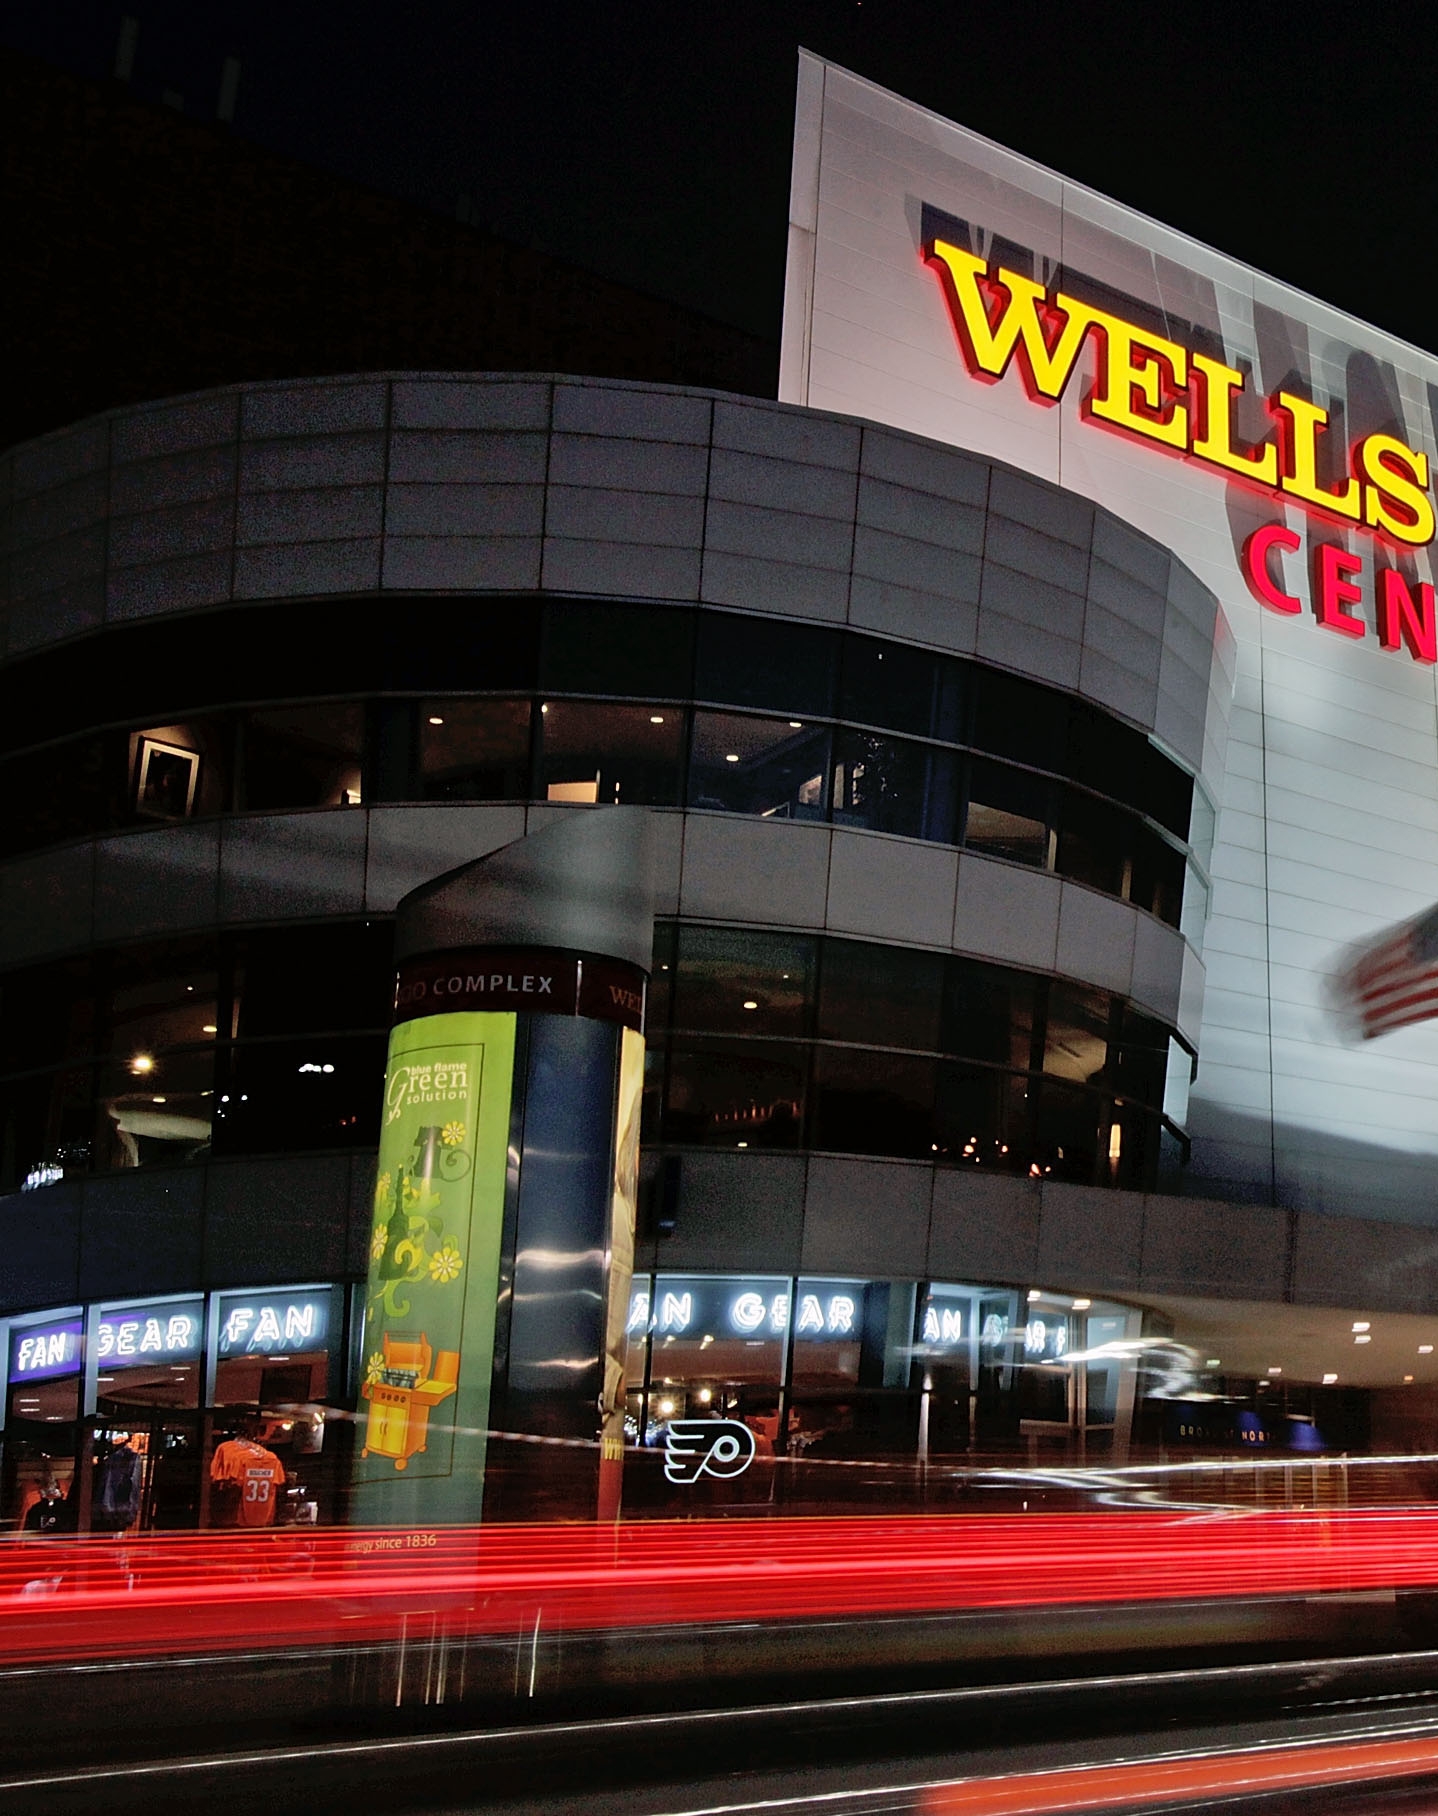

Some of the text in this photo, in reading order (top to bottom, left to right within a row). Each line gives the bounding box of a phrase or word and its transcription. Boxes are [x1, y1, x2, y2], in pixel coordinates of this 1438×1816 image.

[925, 238, 1437, 549] WELLS
[433, 974, 553, 996] COMPLEX
[411, 1062, 467, 1076] blue flame
[386, 1066, 468, 1126] Green
[407, 1089, 467, 1105] solution
[627, 1292, 855, 1332] AN GEAR
[923, 1307, 961, 1343] AN
[18, 1303, 314, 1371] FAN GEAR FAN
[245, 1480, 270, 1502] 33
[375, 1537, 402, 1550] since
[406, 1534, 437, 1548] 1836
